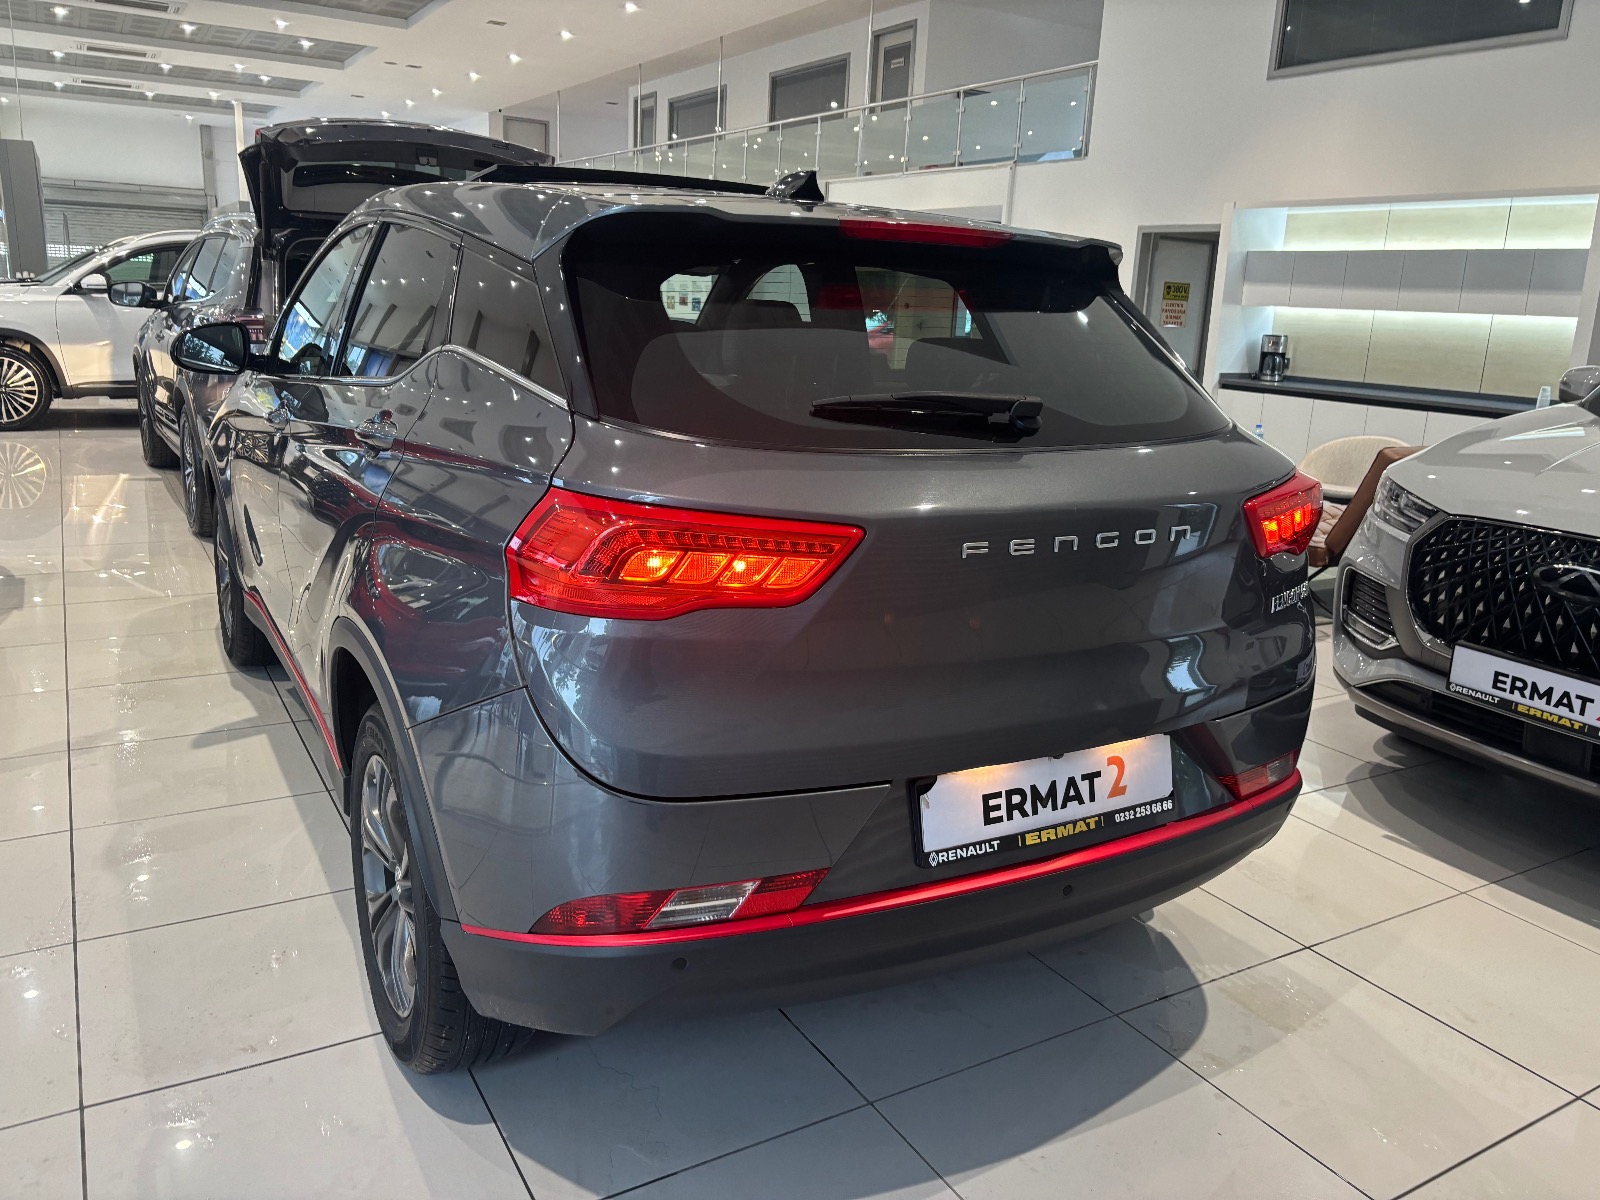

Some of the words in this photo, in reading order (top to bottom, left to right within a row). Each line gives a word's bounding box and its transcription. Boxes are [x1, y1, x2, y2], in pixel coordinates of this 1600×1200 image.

[1456, 685, 1500, 704] RENAULT
[1492, 670, 1595, 717] ERMAT
[1517, 704, 1584, 730] ERMAT
[982, 770, 1101, 826] ERMAT
[1107, 755, 1128, 799] 2
[1115, 810, 1134, 822] 0232
[1136, 805, 1150, 817] 253
[1152, 802, 1162, 813] 66
[1163, 799, 1173, 810] 66
[1025, 817, 1099, 846] ERMAT
[938, 840, 1000, 864] RENAULT
